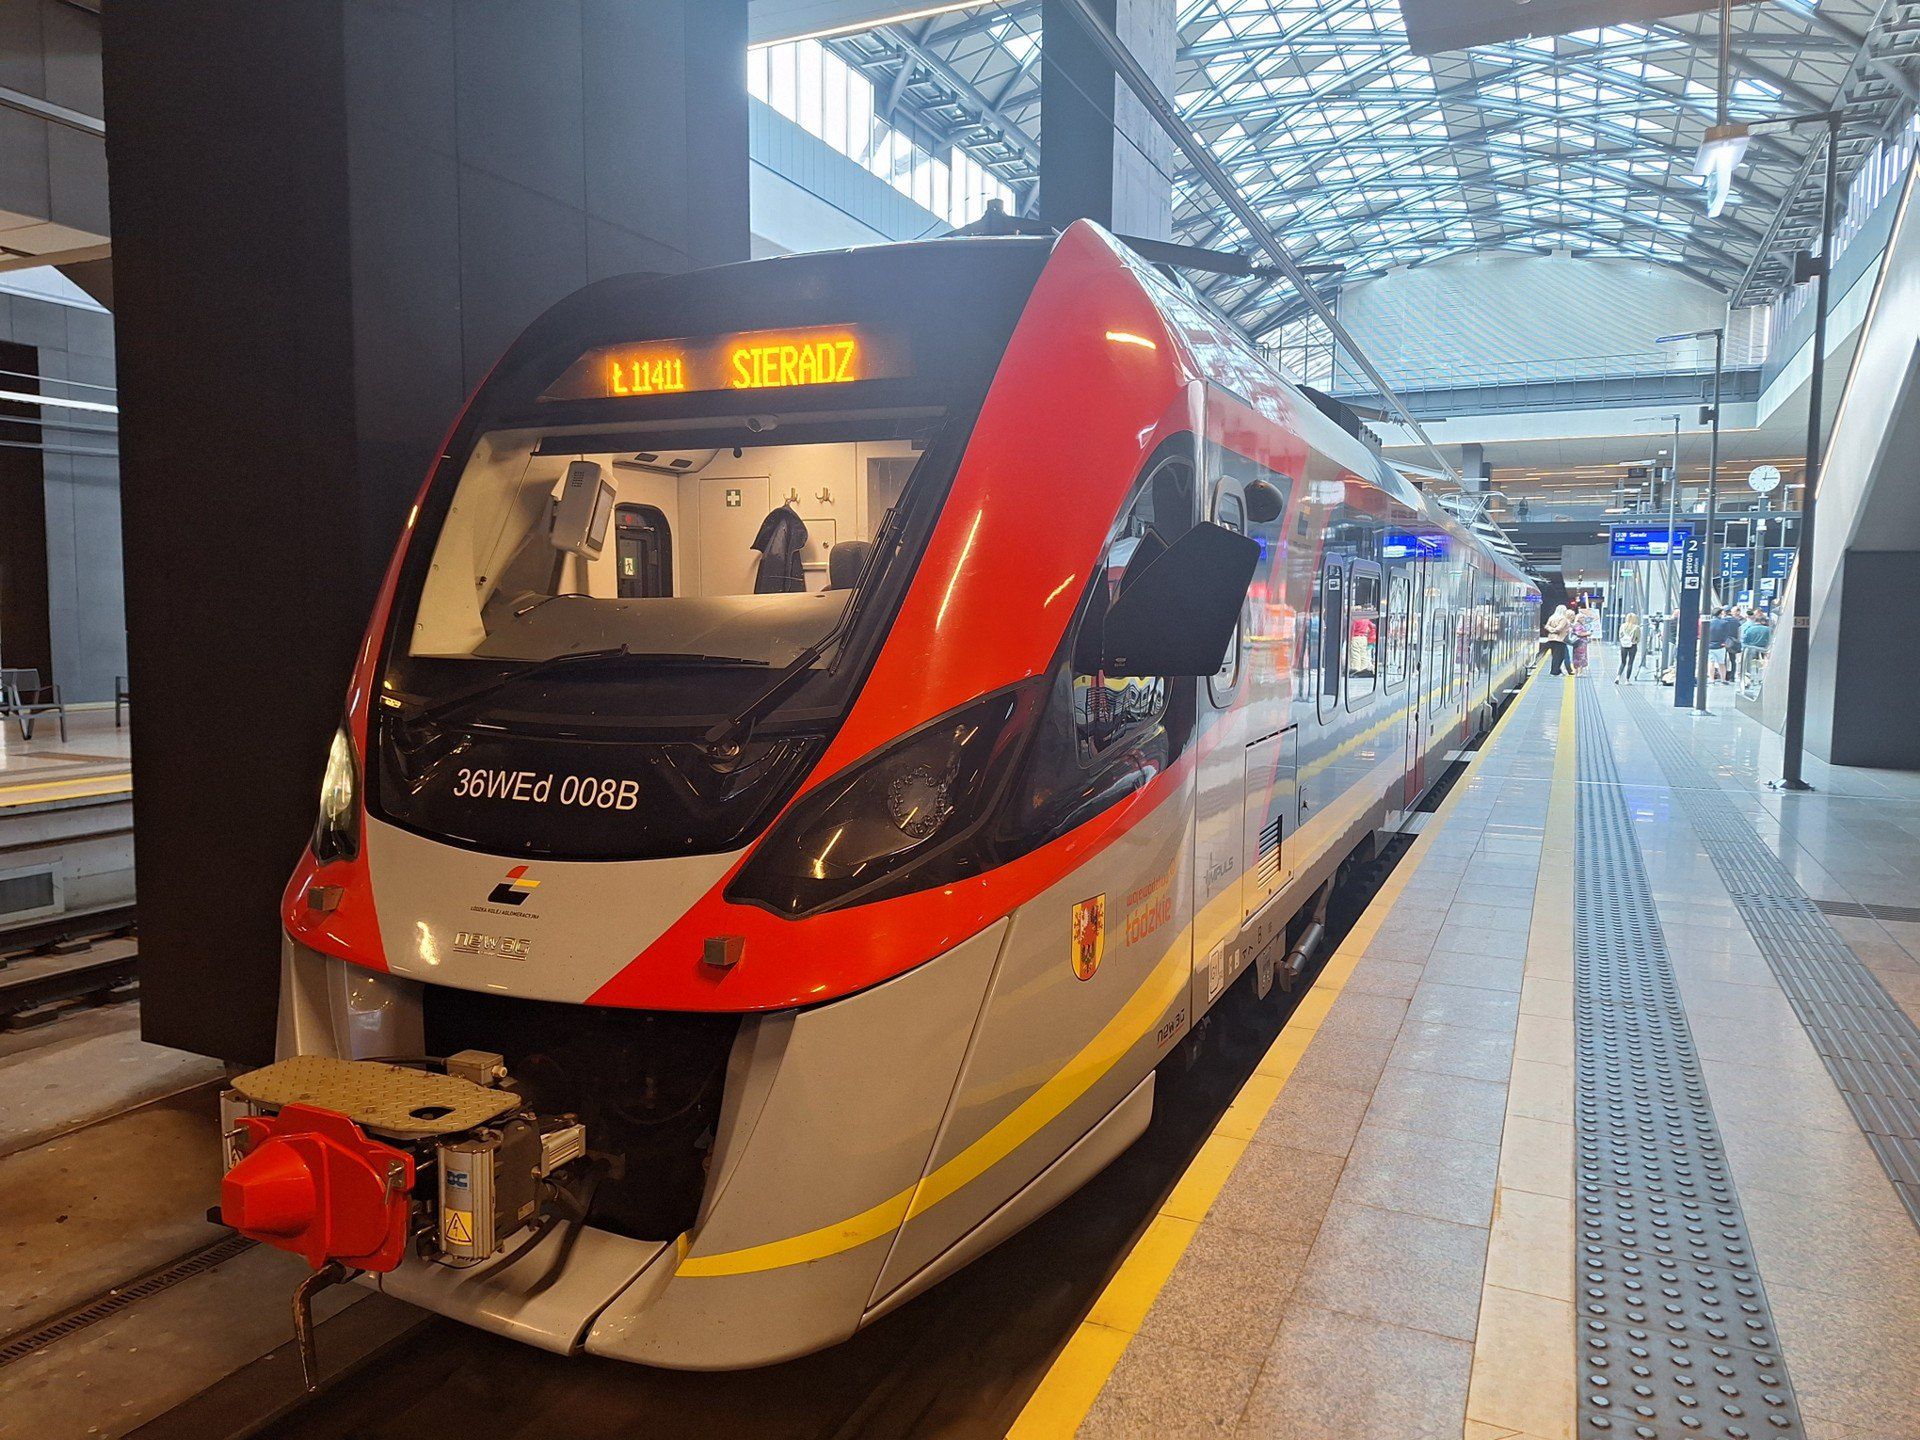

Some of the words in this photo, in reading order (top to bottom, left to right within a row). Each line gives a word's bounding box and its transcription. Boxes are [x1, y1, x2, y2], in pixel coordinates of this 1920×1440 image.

[632, 358, 685, 392] 11411
[732, 340, 855, 389] SIERADZ
[1688, 540, 1698, 551] 2
[1723, 552, 1730, 560] 2
[1686, 552, 1694, 575] peron
[453, 768, 554, 803] 36WEd
[560, 775, 640, 811] 008B
